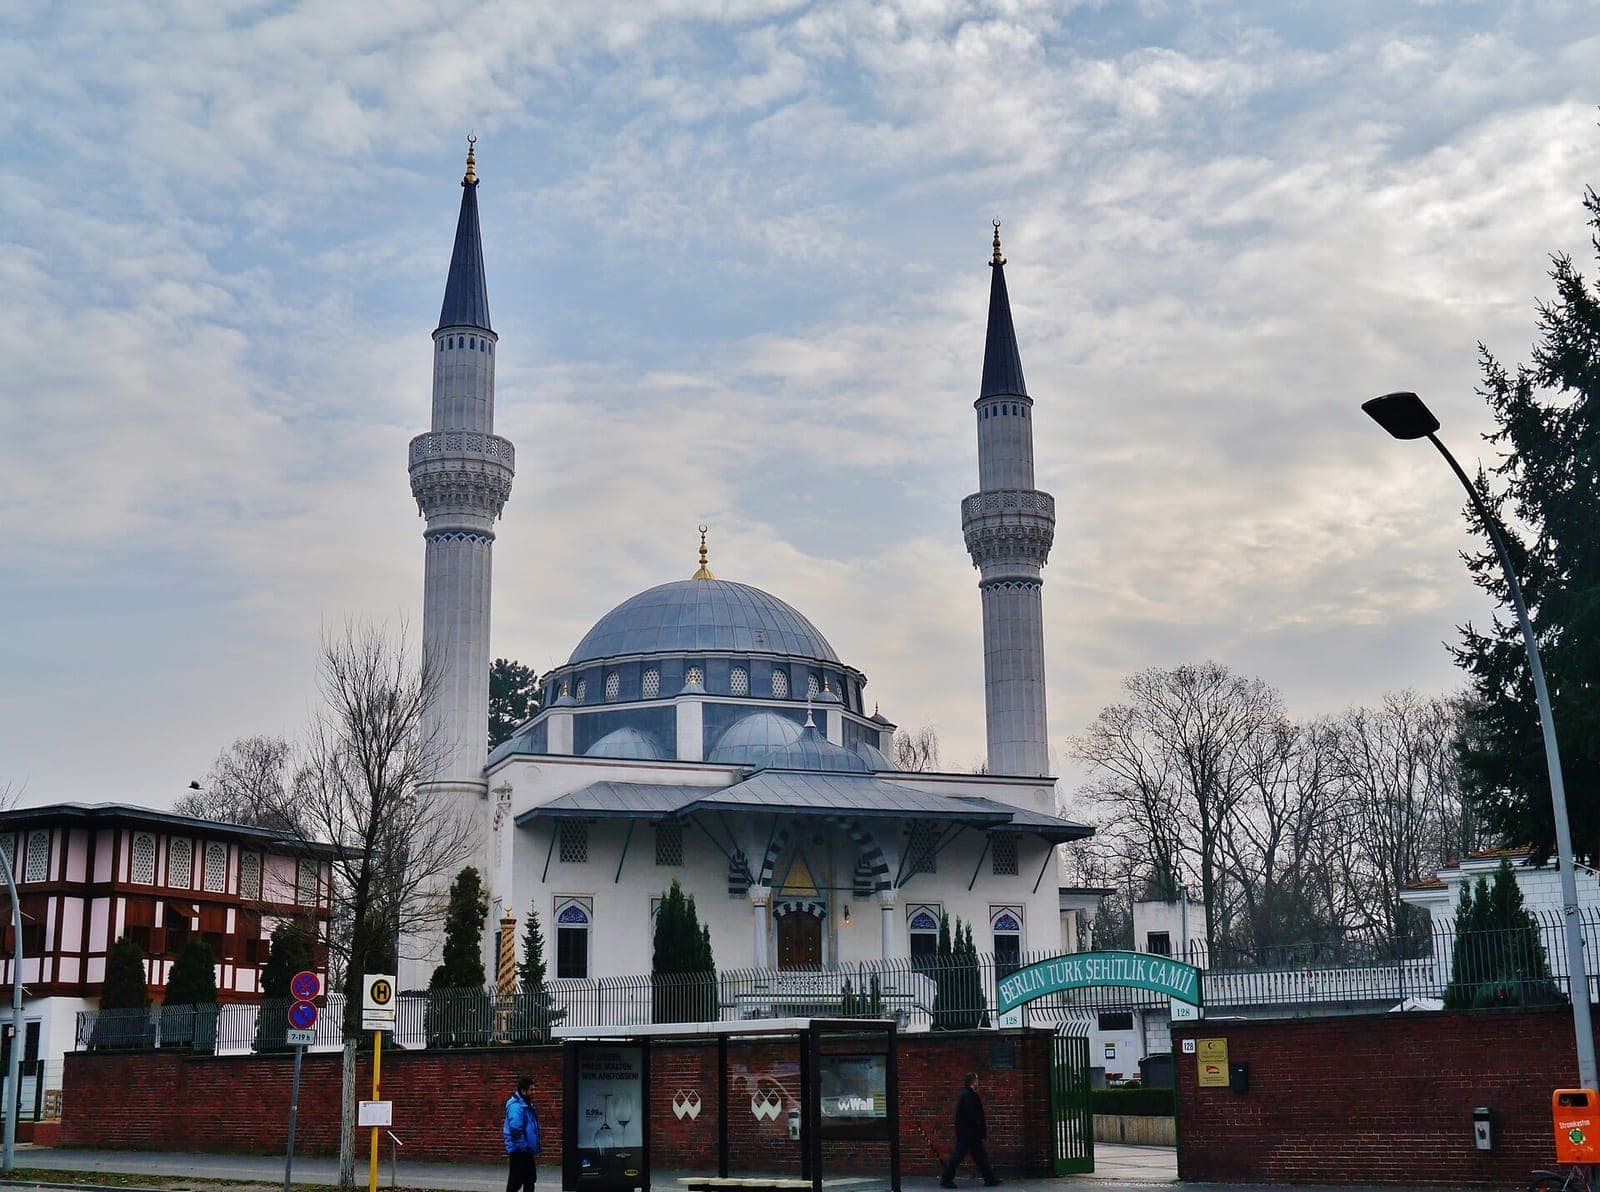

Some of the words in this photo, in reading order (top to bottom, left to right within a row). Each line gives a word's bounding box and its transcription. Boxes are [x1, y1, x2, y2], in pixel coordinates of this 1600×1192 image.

[1000, 968, 1045, 1004] BERLIN
[1047, 958, 1083, 985] TÜRK
[1085, 954, 1147, 985] ŞEHİTLİK
[377, 984, 388, 1000] H
[1176, 1008, 1190, 1017] 128
[1005, 1016, 1018, 1025] 128
